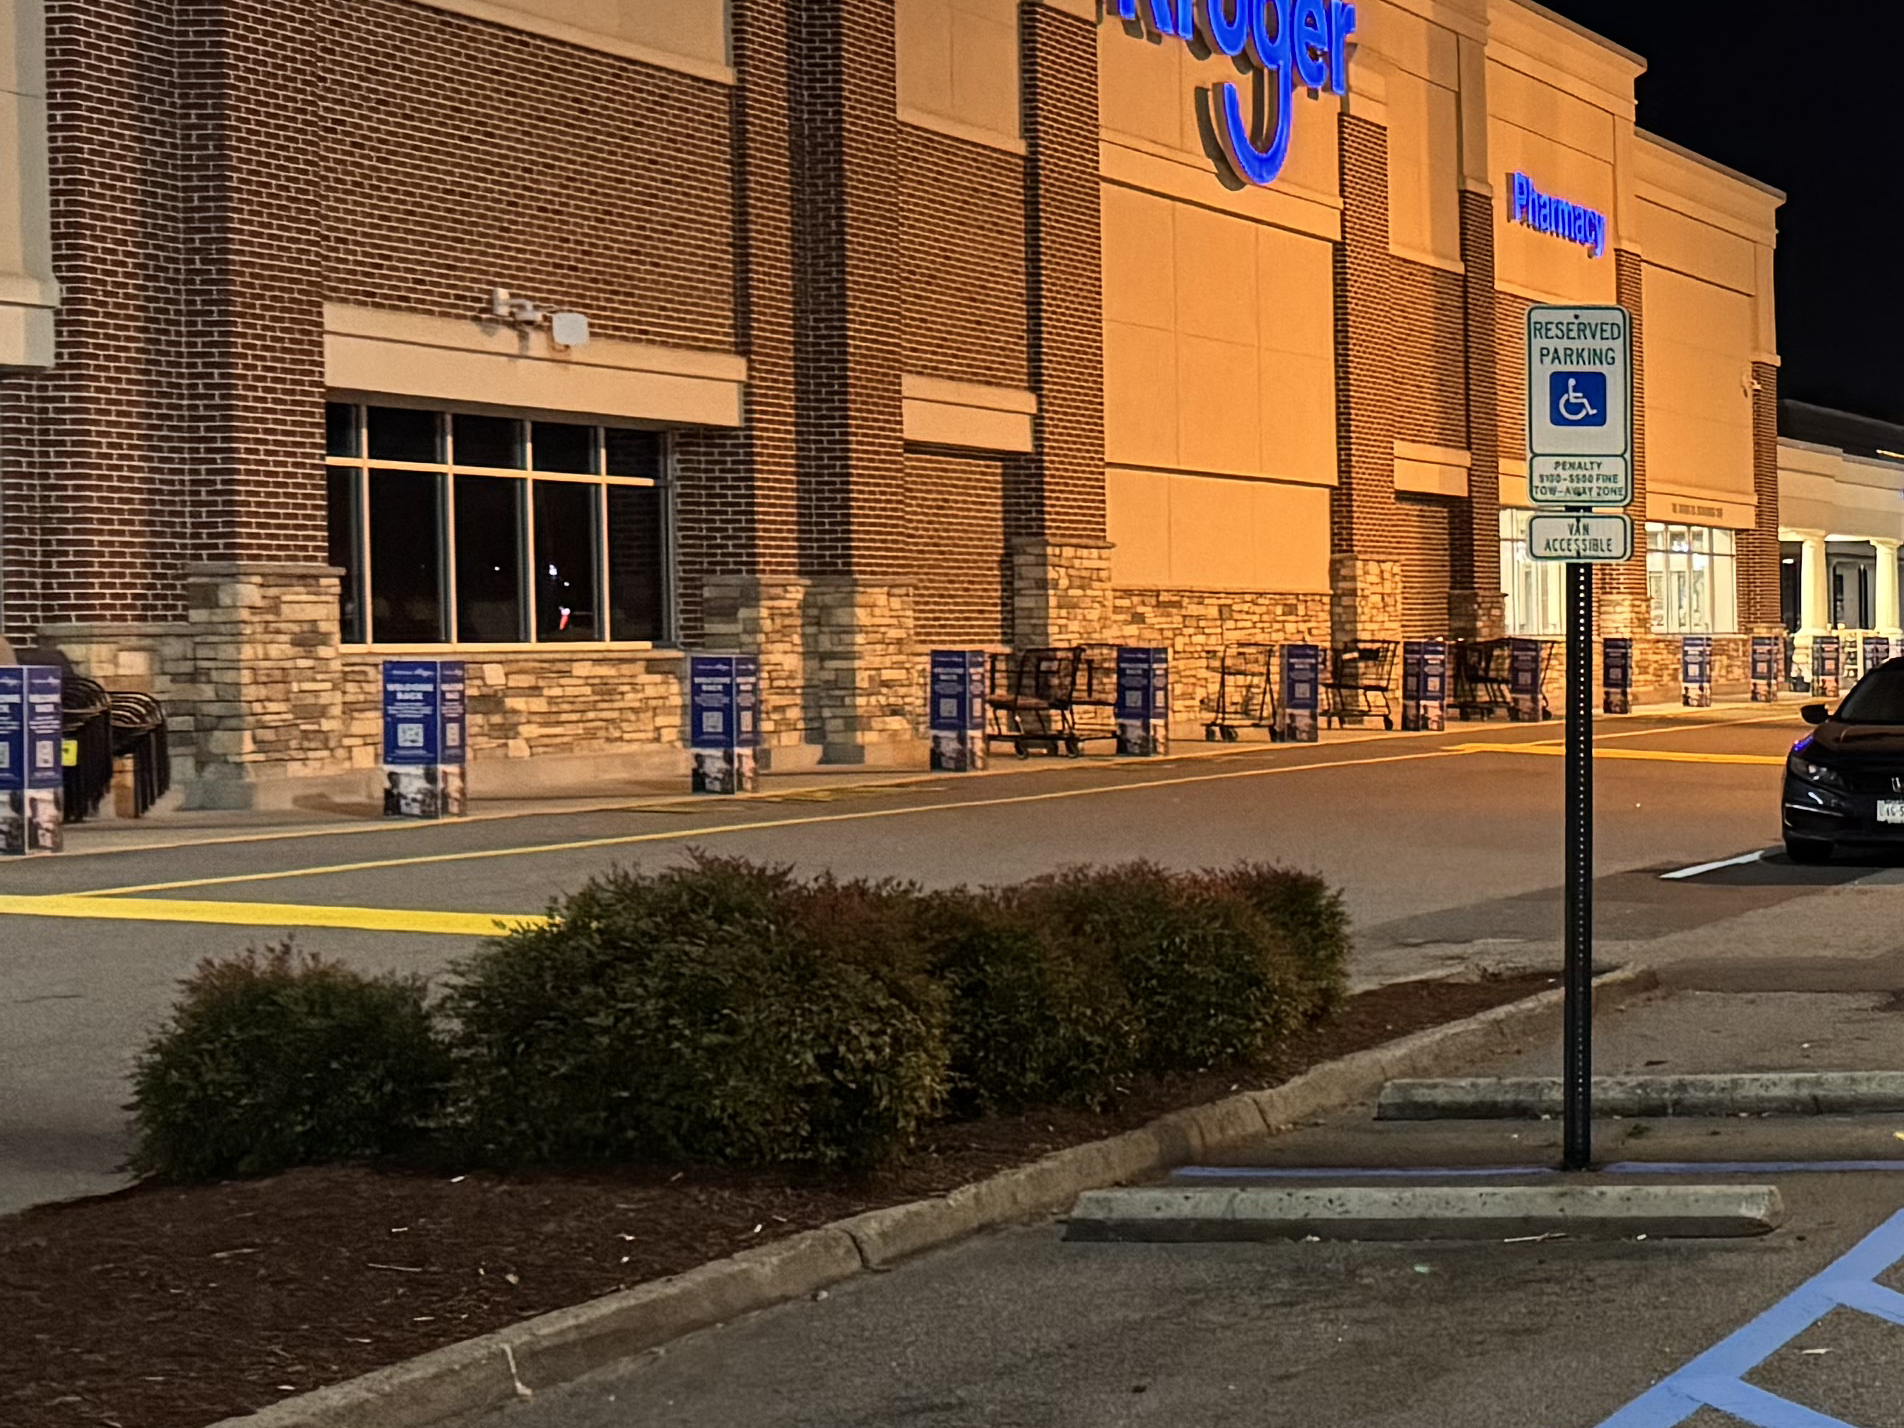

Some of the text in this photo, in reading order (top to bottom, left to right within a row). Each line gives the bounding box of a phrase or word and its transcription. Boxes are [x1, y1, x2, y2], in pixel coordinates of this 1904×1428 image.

[1514, 171, 1606, 258] Pharmacy
[1533, 321, 1622, 341] RESERVED
[1539, 347, 1616, 366] PARKING
[1554, 460, 1603, 471] PENALTY
[1596, 474, 1619, 484] FINE
[1533, 485, 1624, 496] TOW-AWAY ZONE
[1567, 523, 1590, 536] VAN
[1544, 538, 1613, 553] ACCESSIBLE
